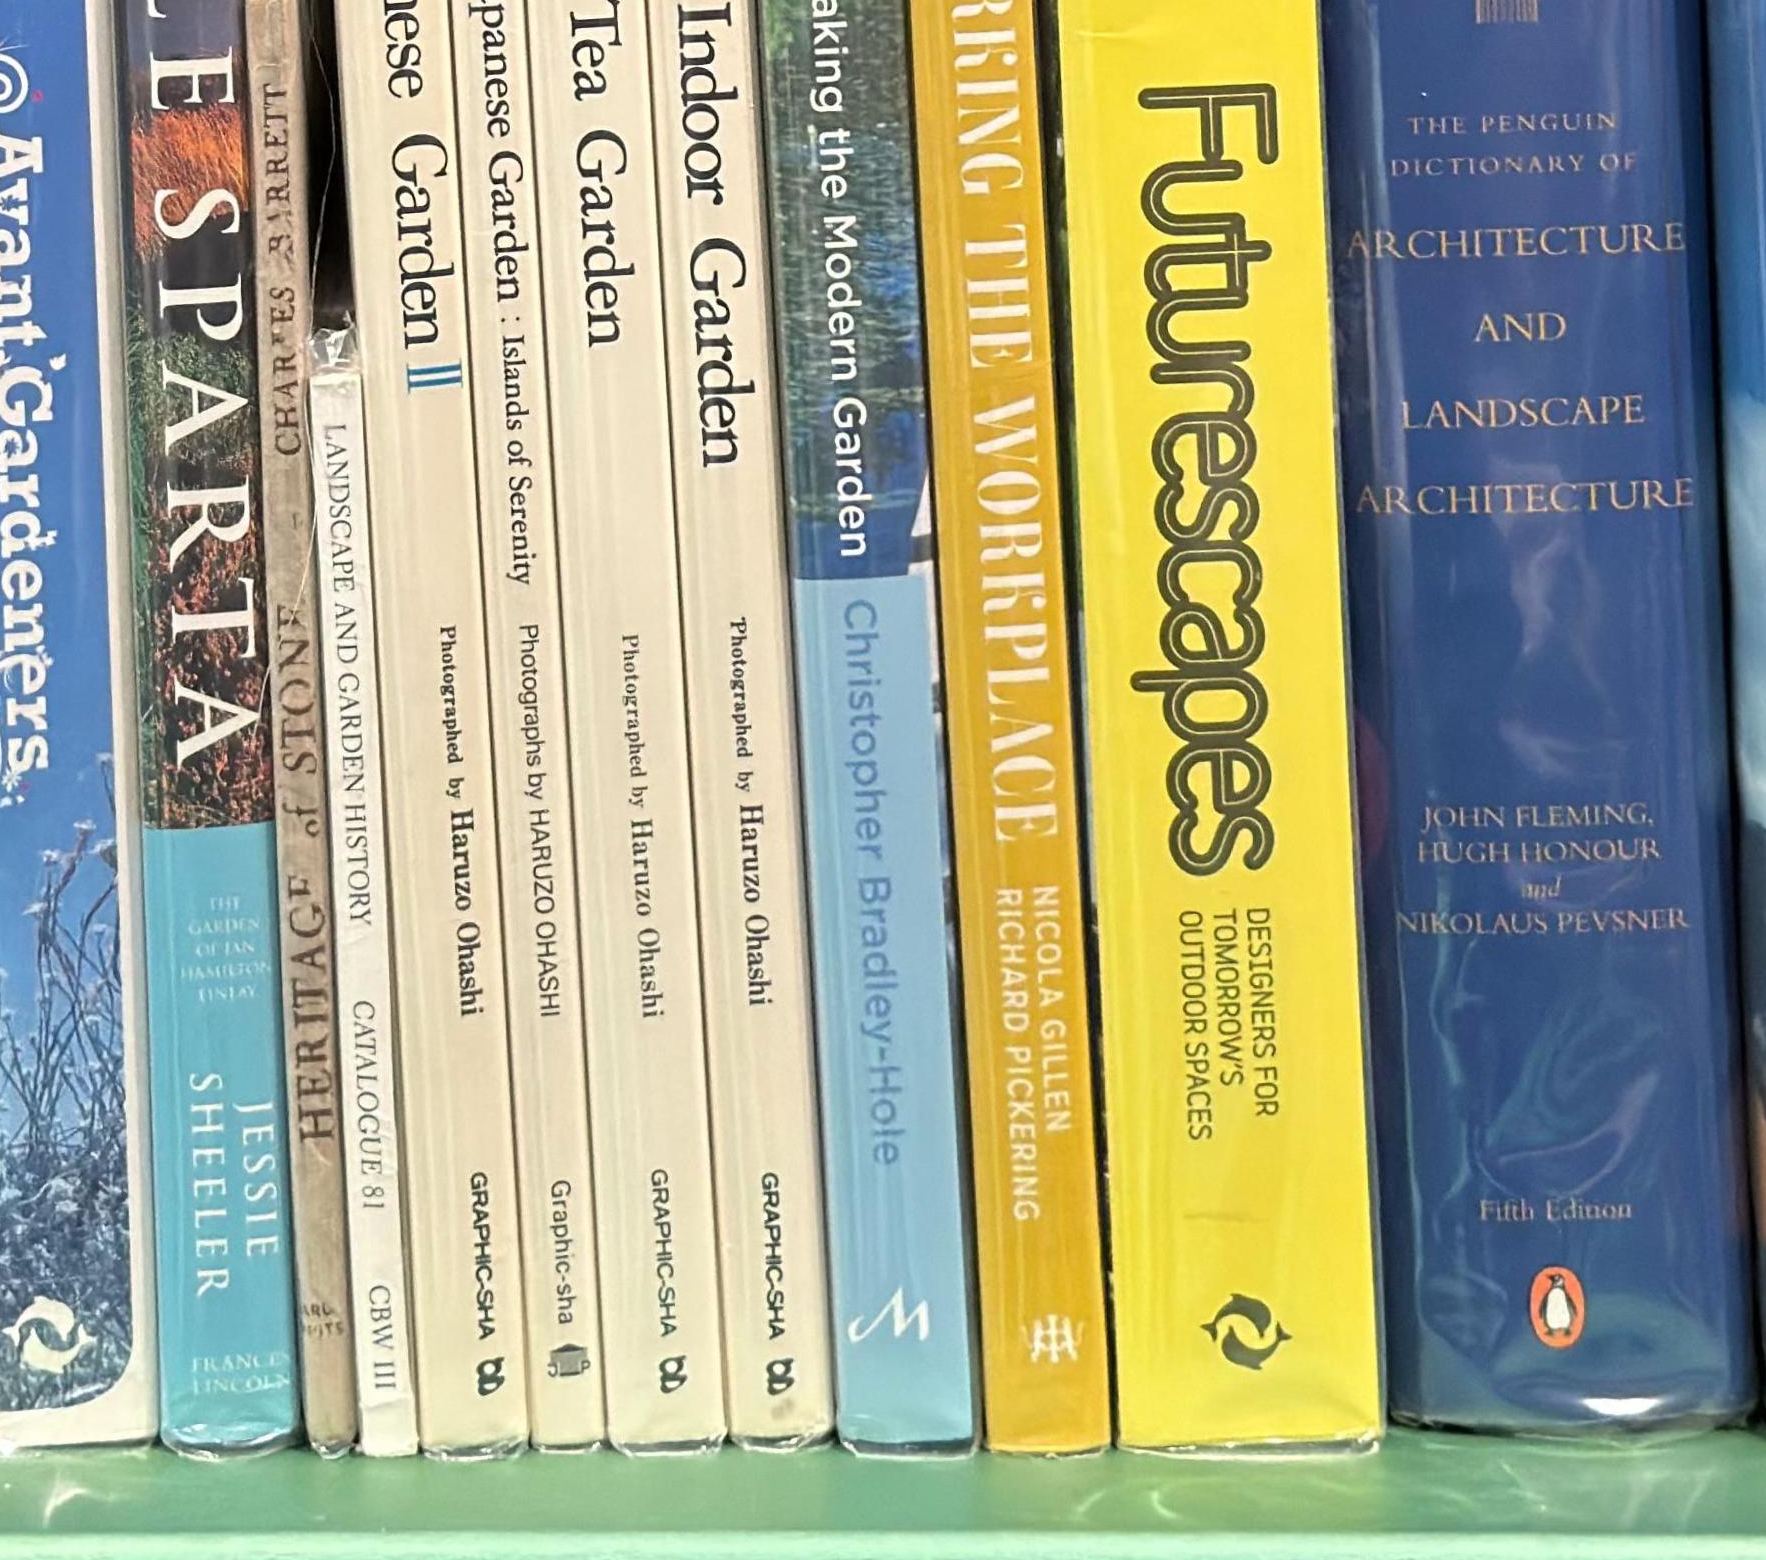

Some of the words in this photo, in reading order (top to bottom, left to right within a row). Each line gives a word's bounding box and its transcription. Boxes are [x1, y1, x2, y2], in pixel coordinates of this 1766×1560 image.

[676, 0, 739, 207] Indoor
[818, 128, 855, 199] the
[1390, 153, 1585, 179] DICTIONARY
[1600, 153, 1637, 174] OF
[1408, 115, 1465, 135] THE
[1481, 112, 1617, 135] PENGUIN
[391, 133, 456, 350] Garden
[488, 149, 529, 303] Garden
[575, 129, 635, 348] Garden
[964, 223, 1034, 368] THE
[1346, 221, 1687, 261] ARCHITECTURE
[689, 237, 756, 469] Garden
[823, 215, 863, 383] Modern
[1474, 311, 1568, 343] AND
[406, 358, 463, 395] II
[501, 333, 530, 432] Islands
[1401, 393, 1646, 431] LANDSCAPE
[153, 187, 262, 770] SPARTA
[323, 423, 357, 593] LANDSCAPE
[506, 440, 532, 467] of
[833, 396, 874, 557] Garden
[1130, 83, 1280, 877] Futurescapes
[1355, 477, 1696, 516] ARCHITECTURE
[506, 475, 538, 585] Serenity
[334, 601, 359, 665] AND
[973, 396, 1059, 842] WORKPLACE
[336, 672, 367, 793] GARDEN
[518, 625, 548, 768] Photographs
[844, 598, 889, 862] Christopher
[527, 772, 547, 801] by
[343, 802, 373, 927] HISTORY
[529, 808, 556, 916] HARUZO
[534, 920, 561, 1018] OHASHI
[994, 887, 1031, 1035] RICHARD
[1032, 885, 1065, 1009] NICOLA
[1178, 909, 1209, 1035] OUTDOOR
[1213, 908, 1244, 1088] TOMORROW'S
[1246, 906, 1278, 1061] DESIGNERS
[352, 999, 384, 1176] CATALOGUE
[857, 876, 908, 1168] Bradley-Hole
[1040, 1019, 1072, 1134] GILLEN
[1184, 1040, 1214, 1142] SPACES
[1254, 1065, 1280, 1118] FOR
[189, 1072, 230, 1298] SHEELER
[233, 1101, 280, 1258] JESSIE
[1004, 1044, 1041, 1223] PICKERING
[368, 1284, 395, 1352] CBW
[469, 1171, 497, 1341] GRAPHIC-SHA
[549, 1179, 578, 1325] Graphic-sha
[649, 1168, 678, 1338] GRAPHIC-SHA
[760, 1172, 787, 1341] GRAPHIC-SHA
